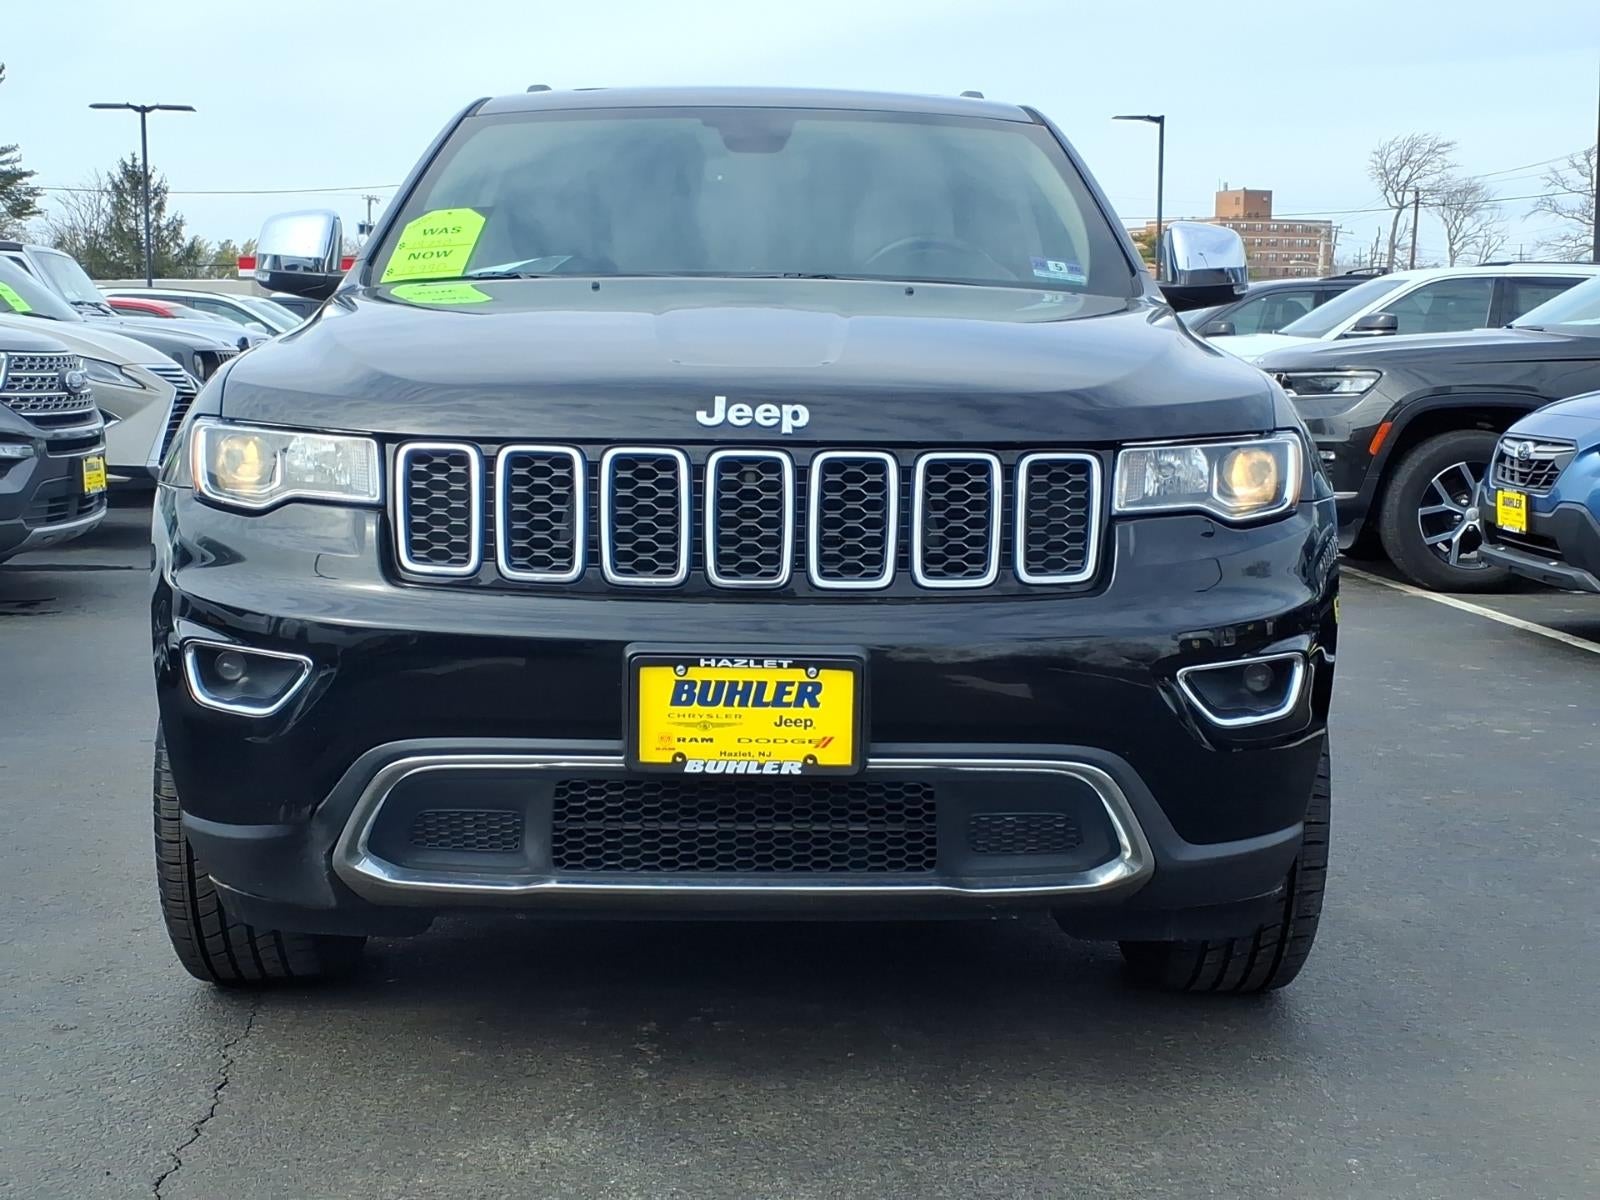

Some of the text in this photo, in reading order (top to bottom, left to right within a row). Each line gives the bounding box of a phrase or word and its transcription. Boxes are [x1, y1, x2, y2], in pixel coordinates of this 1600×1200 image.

[423, 226, 462, 236] WAS
[407, 250, 453, 261] NOW
[696, 396, 809, 433] Jeep
[700, 658, 793, 668] HAZLET
[670, 679, 823, 709] BUHLER
[774, 715, 813, 730] Jeep
[684, 759, 802, 775] BUHLER
